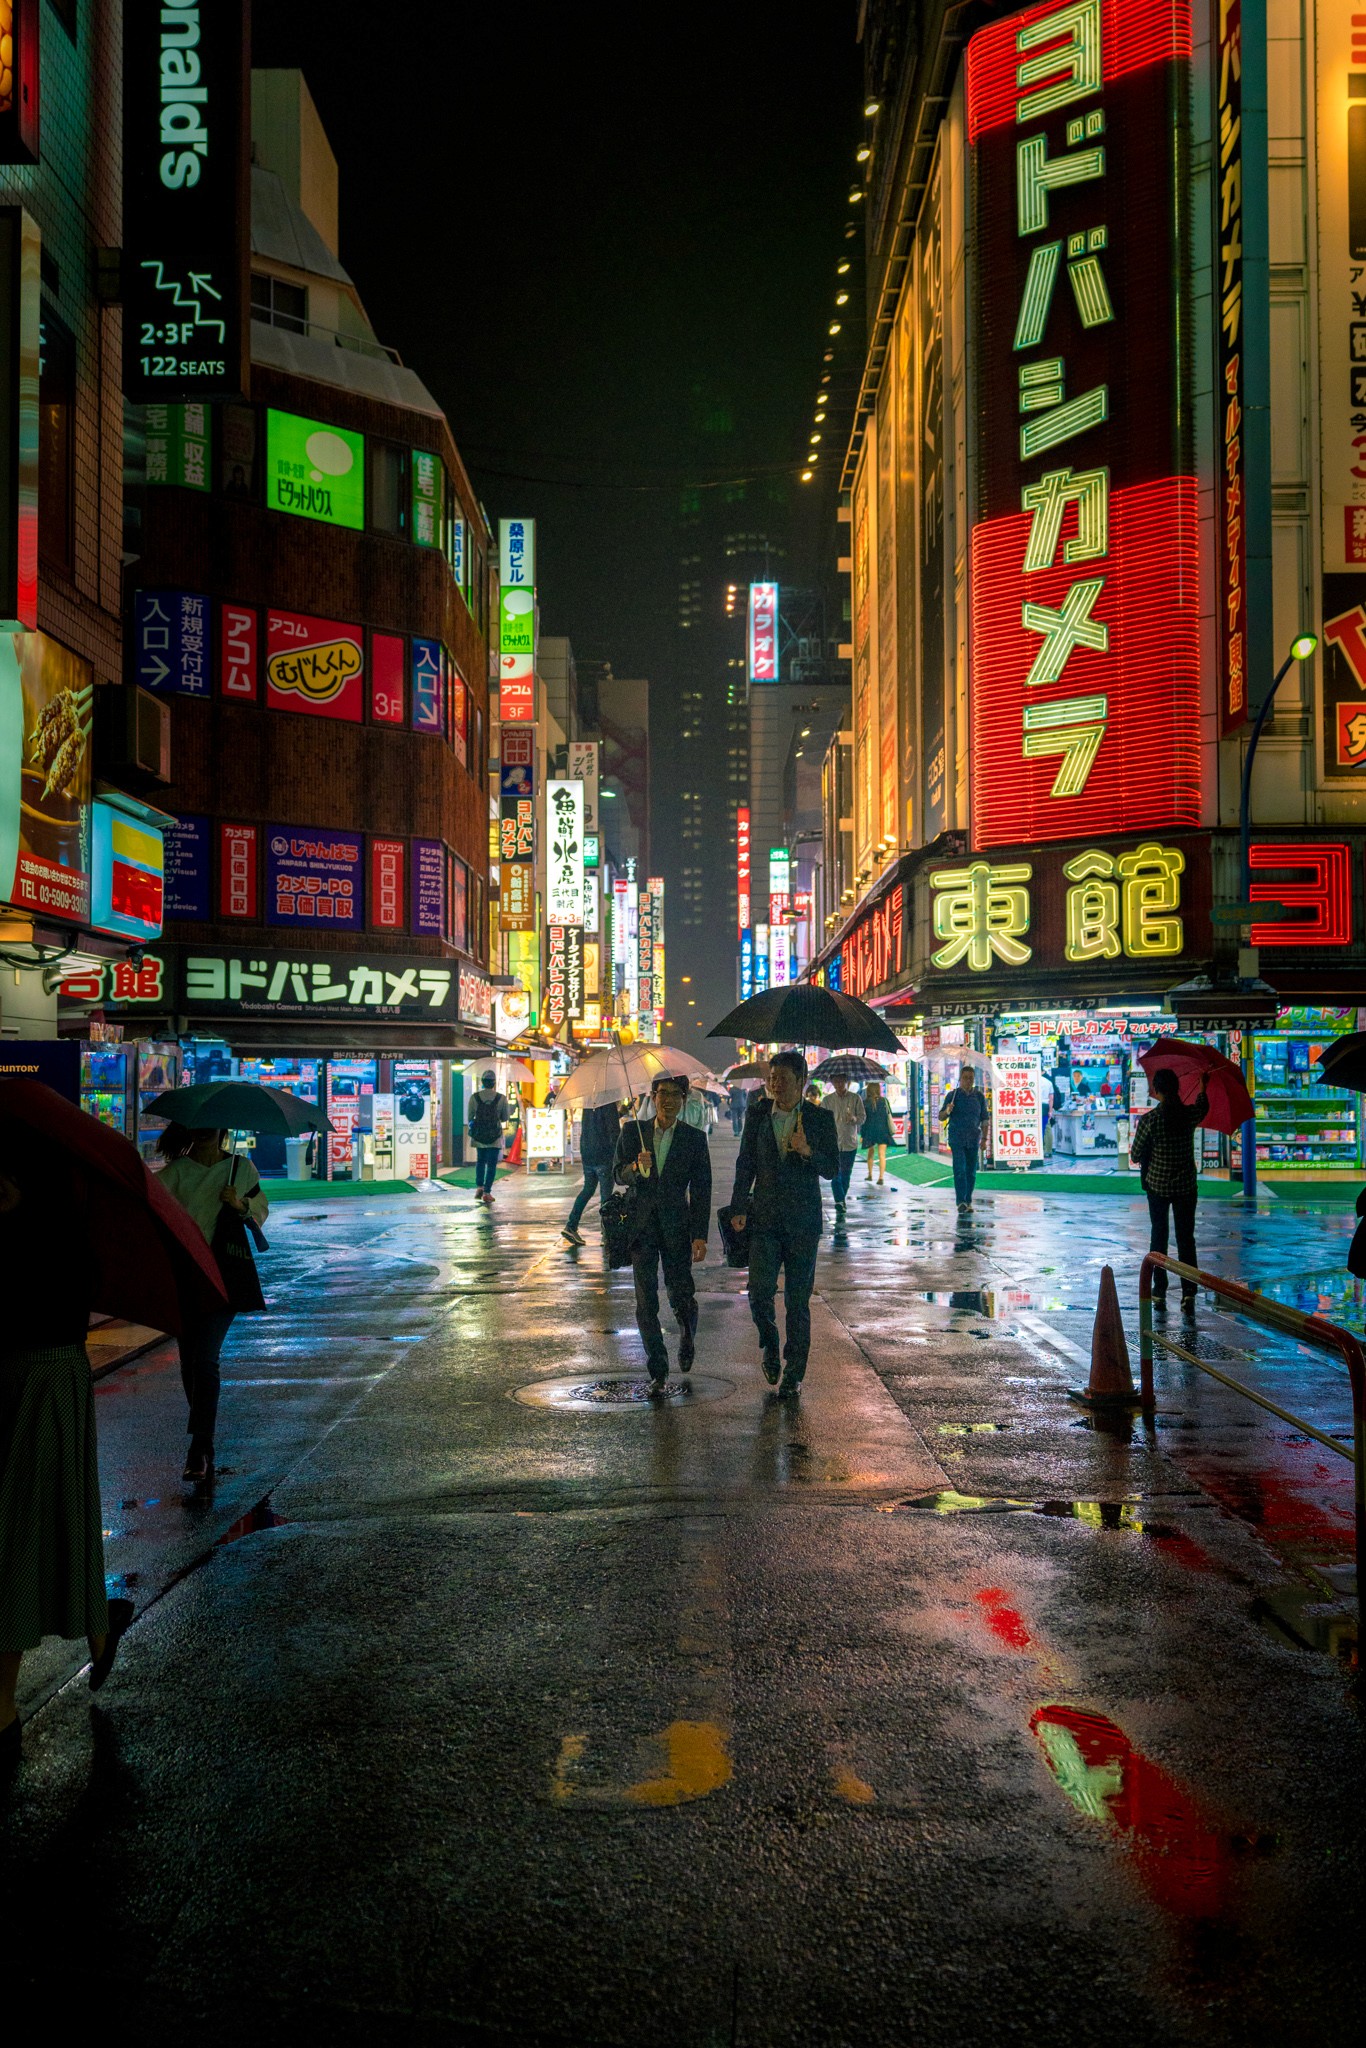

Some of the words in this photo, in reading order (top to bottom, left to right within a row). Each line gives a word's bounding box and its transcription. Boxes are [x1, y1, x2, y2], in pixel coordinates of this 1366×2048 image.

[159, 0, 208, 189] nald's
[140, 357, 177, 376] 122
[179, 361, 225, 375] SEATS
[1012, 0, 1115, 797] ヨドバシカメラ
[277, 478, 333, 517] ピタットハウス
[509, 522, 525, 583] 桑原ビル
[143, 598, 171, 650] 入口
[180, 596, 204, 691] 新規受付中
[267, 617, 309, 638] アコム
[502, 633, 531, 647] ピタットハウス
[754, 592, 774, 674] カラオケ
[227, 612, 252, 693] アコム
[275, 647, 355, 685] むじんくん
[416, 646, 439, 697] 入口
[374, 693, 402, 717] 3F
[501, 684, 532, 696] アコム
[509, 706, 524, 718] 3F
[502, 819, 516, 858] カメラ
[517, 801, 532, 854] ヨドバシ
[738, 821, 749, 878] カラオケ
[20, 878, 38, 901] TEL
[40, 884, 89, 915] 03-5909-3306
[231, 840, 248, 914] 高価買取
[276, 893, 353, 919] 高価買取
[929, 842, 1186, 972] 東館
[639, 893, 651, 970] ヨドバシカメラ
[186, 956, 452, 1007] ヨドバシカメラ
[549, 927, 565, 1025] ヨドバシカメラ
[567, 928, 581, 1018] ケータイアクセサリー館
[742, 941, 751, 995] カラオケ
[239, 1001, 275, 1010] Yodobashi
[276, 1002, 302, 1011] Camera
[640, 977, 651, 1009] 時計館
[931, 1003, 1011, 1015] ヨドバシカメラ
[1028, 1020, 1128, 1035] ヨドバシカメラ
[1179, 1019, 1275, 1030] ヨドバシカメラ
[999, 1089, 1035, 1107] 税込
[999, 1129, 1037, 1147] 10%
